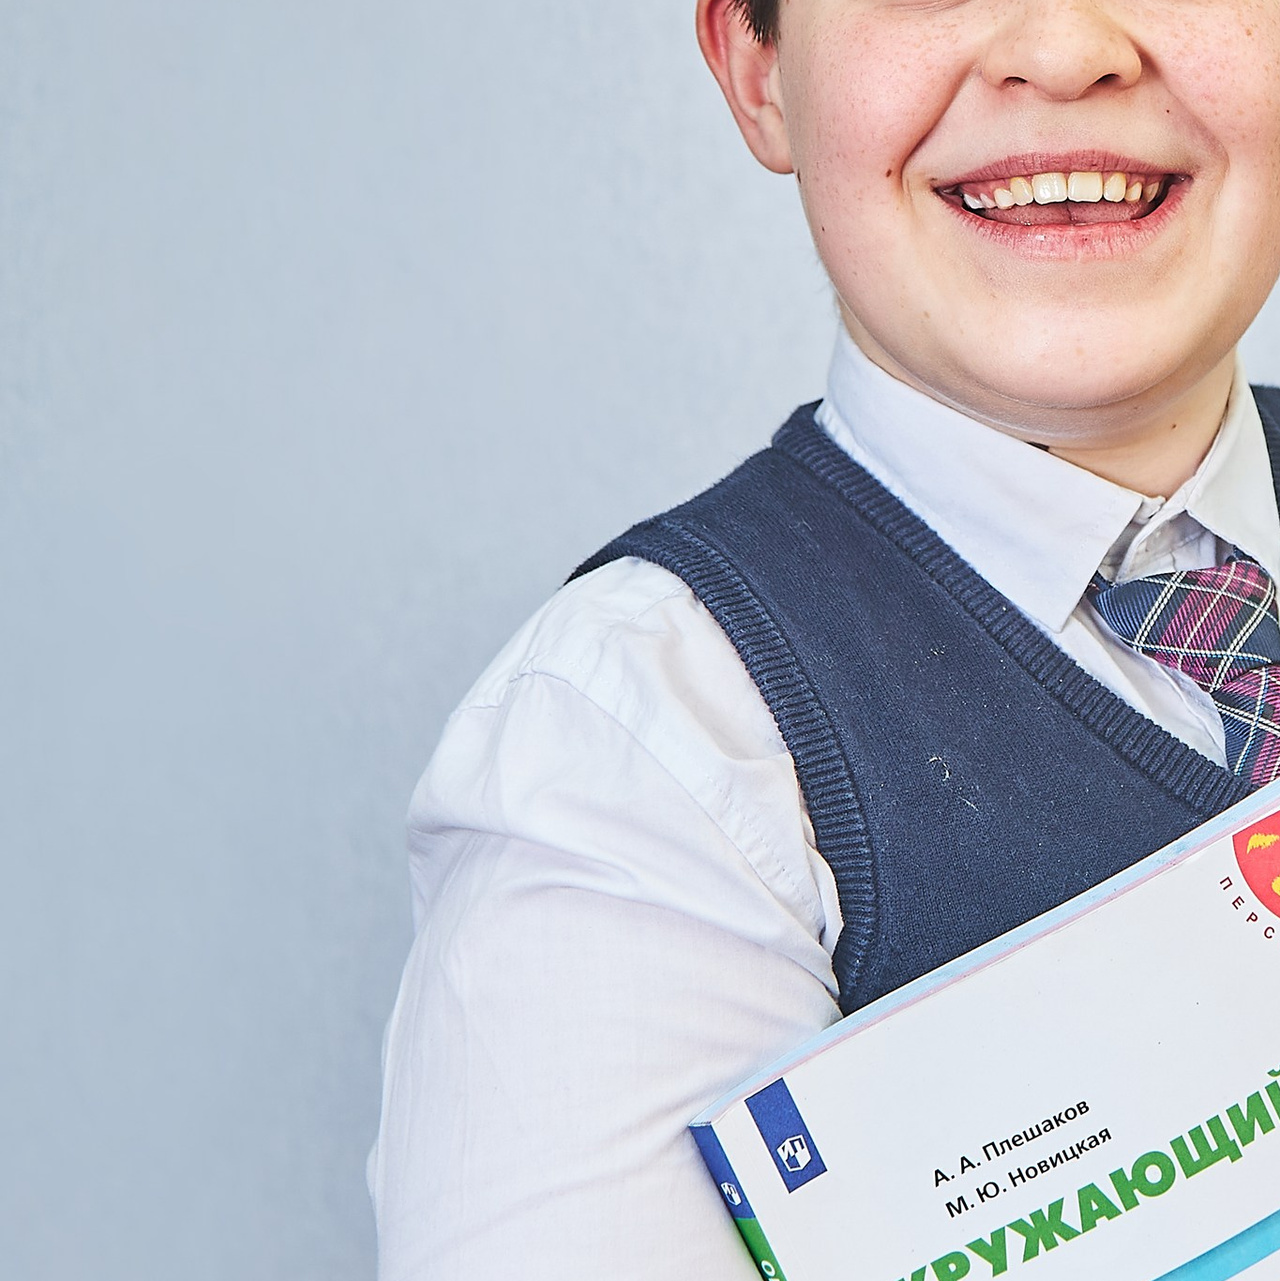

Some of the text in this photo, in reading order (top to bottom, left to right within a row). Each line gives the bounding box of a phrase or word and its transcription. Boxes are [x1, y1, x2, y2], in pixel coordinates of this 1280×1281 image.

[933, 1101, 1090, 1187] А. А. Плешаков
[945, 1128, 1112, 1218] М. Ю. Новицкая
